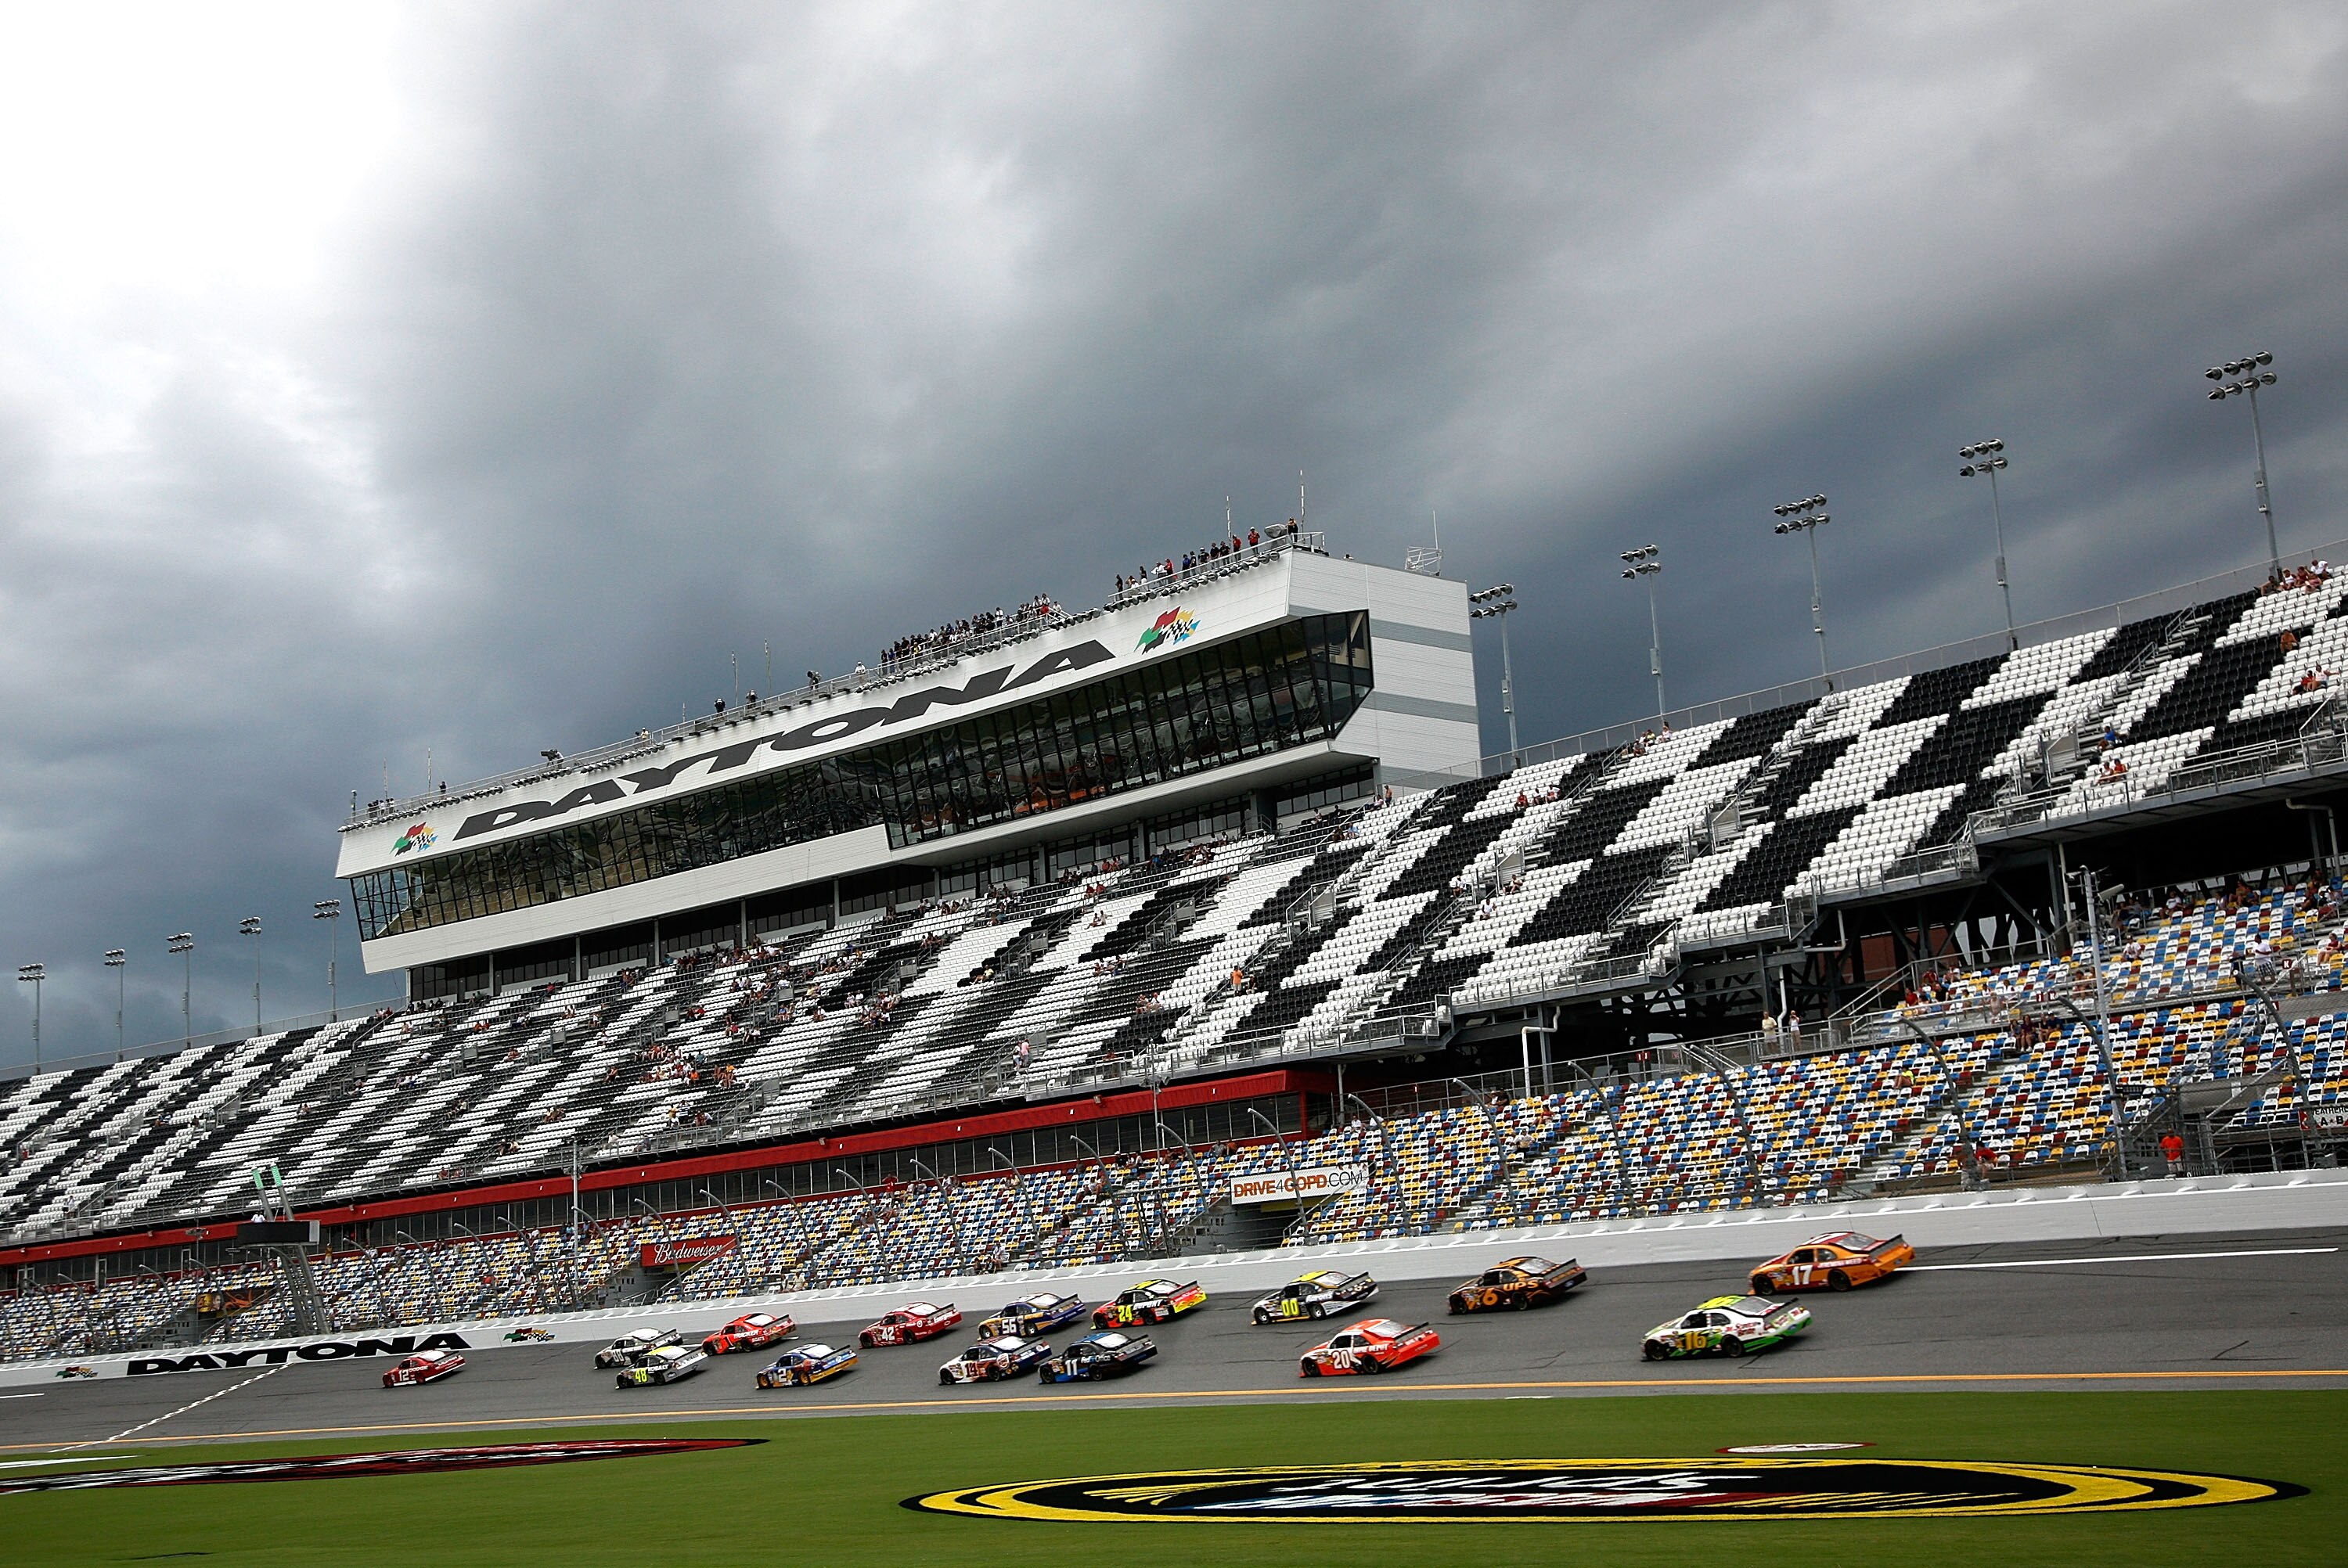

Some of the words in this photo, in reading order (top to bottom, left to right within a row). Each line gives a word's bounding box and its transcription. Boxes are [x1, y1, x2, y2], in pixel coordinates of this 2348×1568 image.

[452, 639, 1116, 841] DAYTONA
[654, 1241, 722, 1264] Budweiser
[1792, 1264, 1813, 1286] 17
[1503, 1279, 1540, 1292] UPS
[1482, 1287, 1499, 1306] 6
[1118, 1304, 1133, 1322] 24
[1280, 1297, 1300, 1318] 00
[733, 1329, 759, 1340] TRACKER
[881, 1325, 895, 1341] 42
[1002, 1318, 1017, 1335] 56
[1685, 1330, 1706, 1350] 16
[127, 1332, 471, 1376] DAYTONA
[1331, 1350, 1351, 1370] 20
[398, 1369, 409, 1382] 12
[635, 1367, 647, 1383] 48
[778, 1368, 787, 1383] 2
[964, 1361, 980, 1378] 14
[1064, 1358, 1078, 1376] 11
[1268, 1471, 1761, 1492] Sprint
